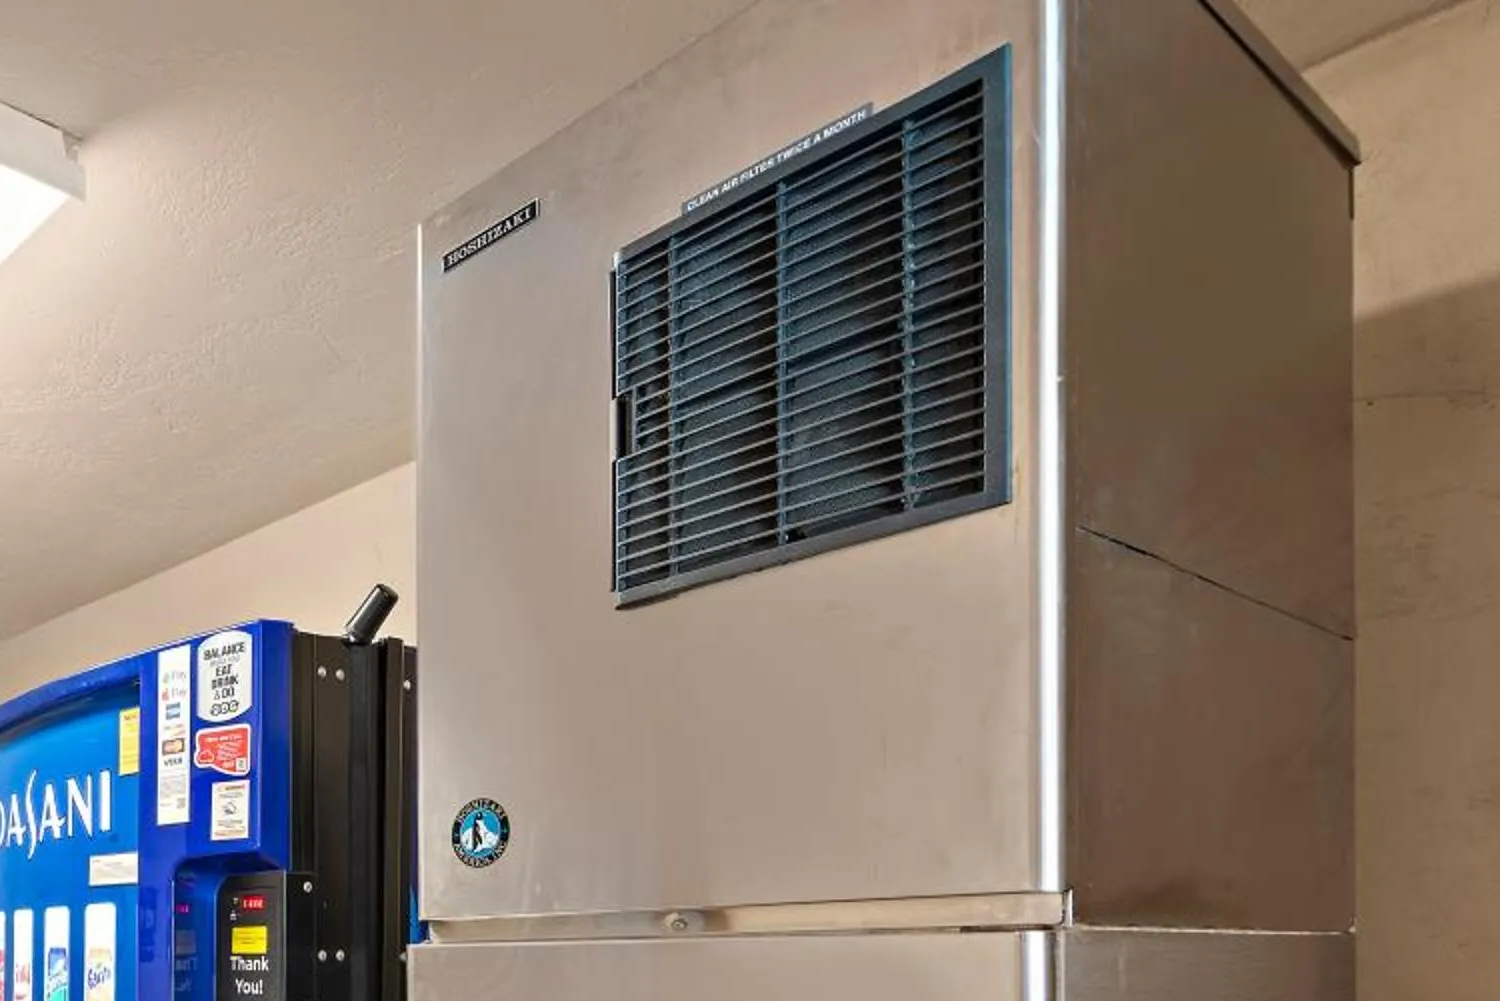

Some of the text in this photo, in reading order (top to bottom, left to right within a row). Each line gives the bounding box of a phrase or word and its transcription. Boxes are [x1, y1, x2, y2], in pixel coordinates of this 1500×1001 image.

[687, 189, 719, 211] CLEAN
[721, 174, 739, 193] AIR
[777, 137, 811, 163] TWICE
[813, 133, 821, 145] A
[823, 109, 866, 138] MONTH
[447, 207, 531, 265] HOSHIZAKI
[203, 641, 245, 661] BALANCE
[215, 663, 232, 676] EAT
[230, 955, 269, 971] Thank
[235, 978, 264, 995] You!
